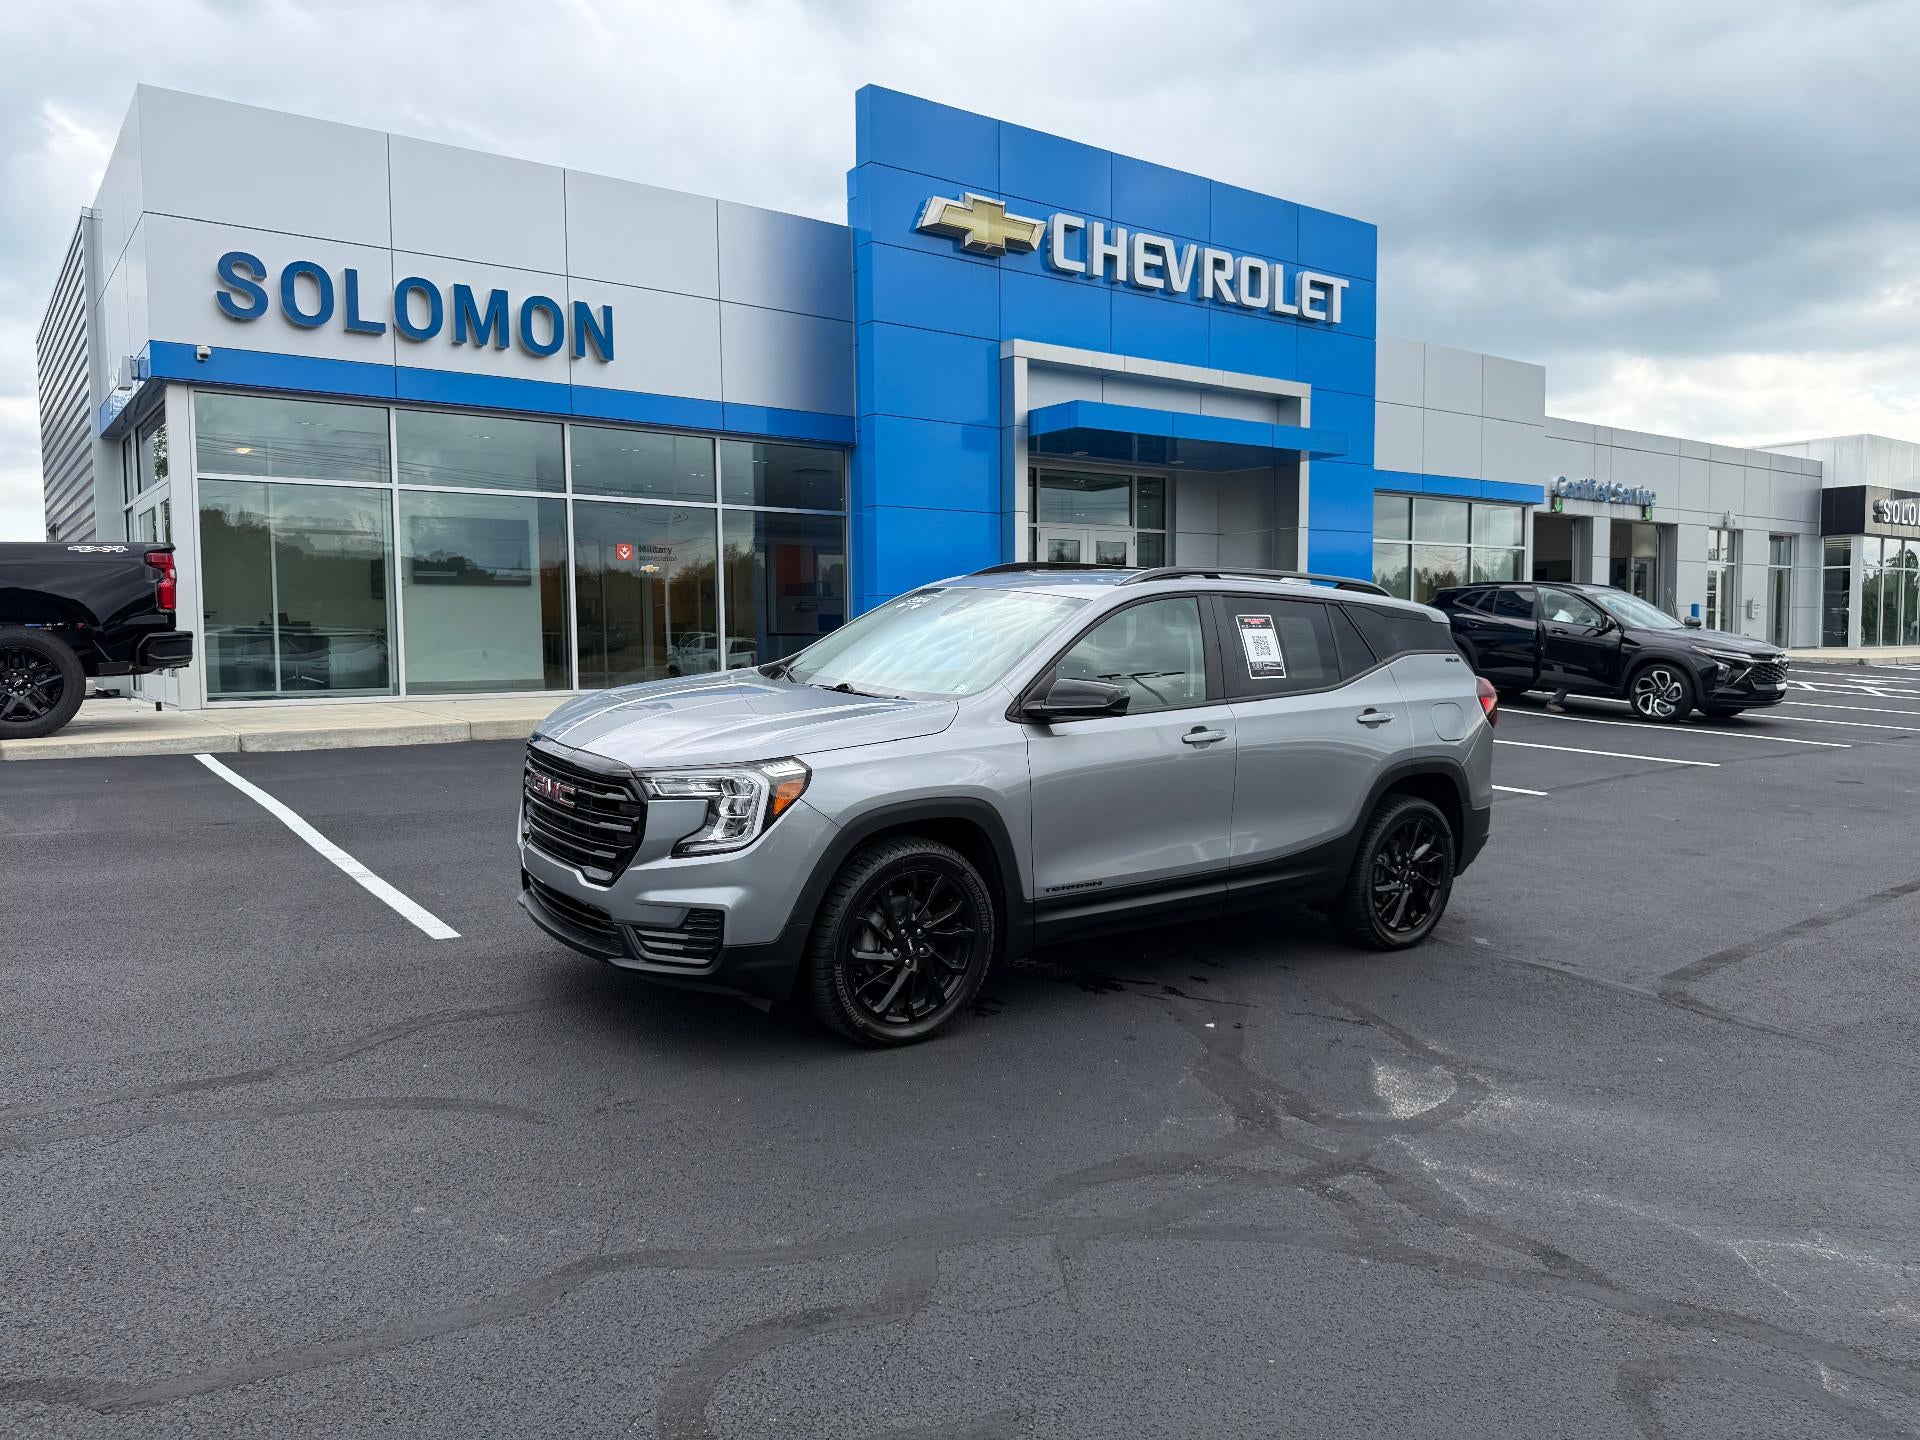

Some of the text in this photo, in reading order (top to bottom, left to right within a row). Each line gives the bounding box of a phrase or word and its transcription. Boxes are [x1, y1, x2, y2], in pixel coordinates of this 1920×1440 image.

[1047, 212, 1350, 324] CHEVROLET
[216, 251, 615, 362] SOLOMON
[1555, 475, 1657, 507] Certified Service
[1873, 499, 1920, 527] SOLO
[638, 544, 673, 555] Military
[531, 770, 577, 810] GMC
[960, 872, 990, 937] BRIDGESTONE
[1043, 880, 1103, 893] TERRAIN
[834, 963, 866, 1029] BRIDGESTONE
